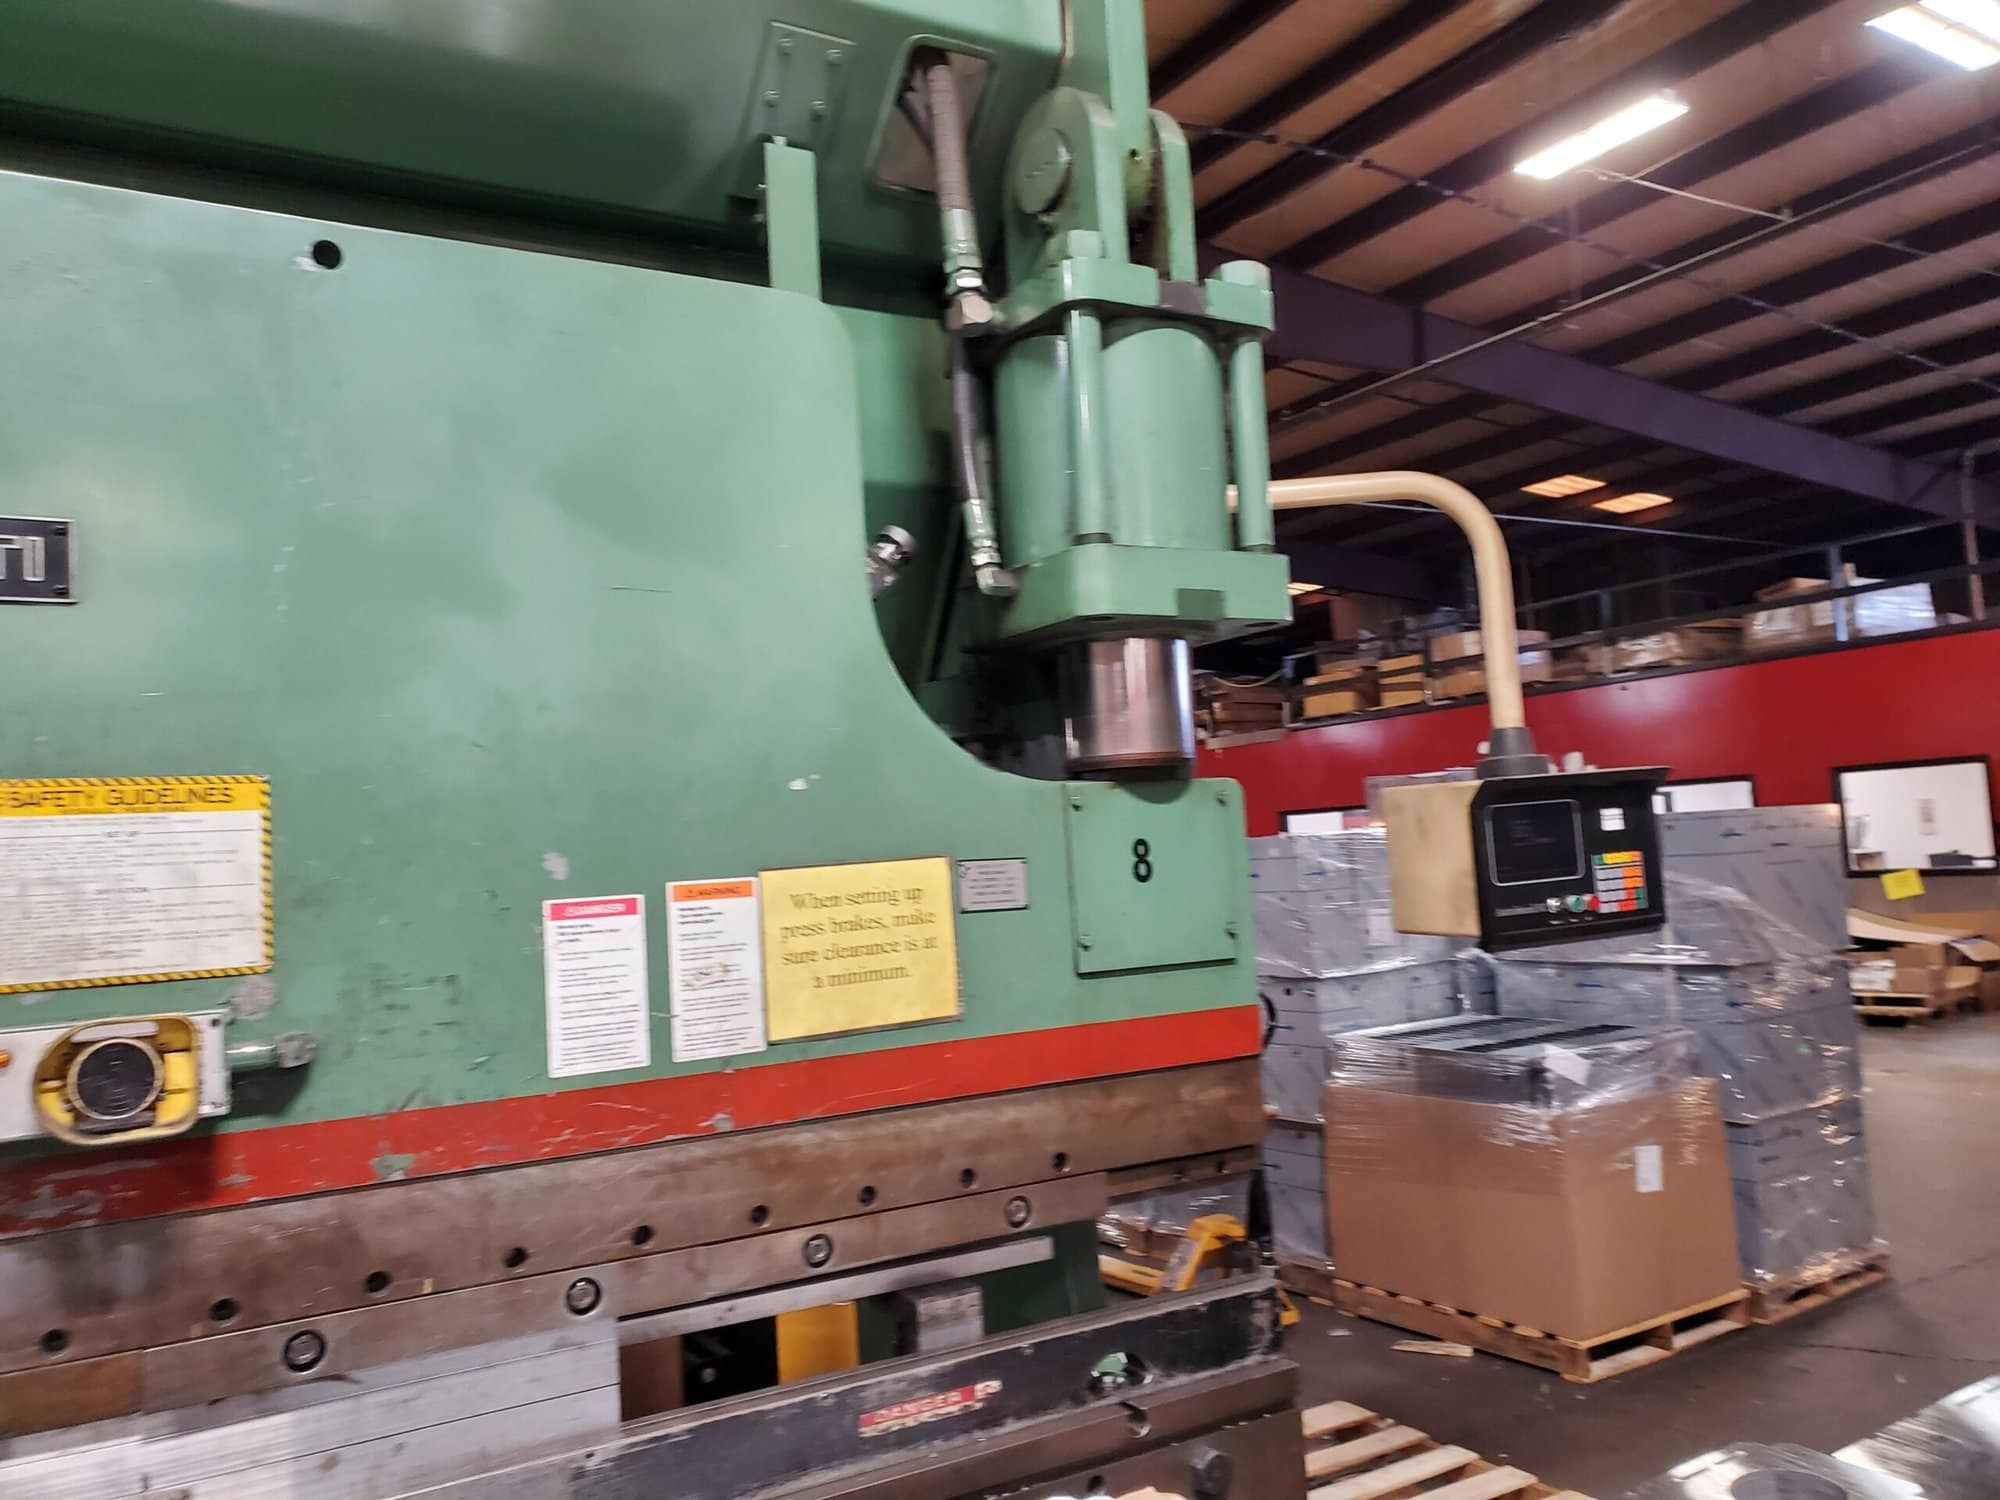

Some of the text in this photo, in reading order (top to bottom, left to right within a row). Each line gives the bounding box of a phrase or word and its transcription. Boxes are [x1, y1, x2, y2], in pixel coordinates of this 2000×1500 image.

[8, 790, 96, 809] SAFETY
[105, 787, 234, 807] GUIDELINES
[1132, 838, 1153, 883] 8
[790, 887, 925, 909] When setting up
[780, 923, 825, 944] press
[893, 910, 936, 928] make
[782, 950, 821, 965] sure
[823, 942, 901, 960] clearance
[904, 935, 920, 951] is
[812, 976, 825, 988] a
[873, 1391, 962, 1422] DANGER
